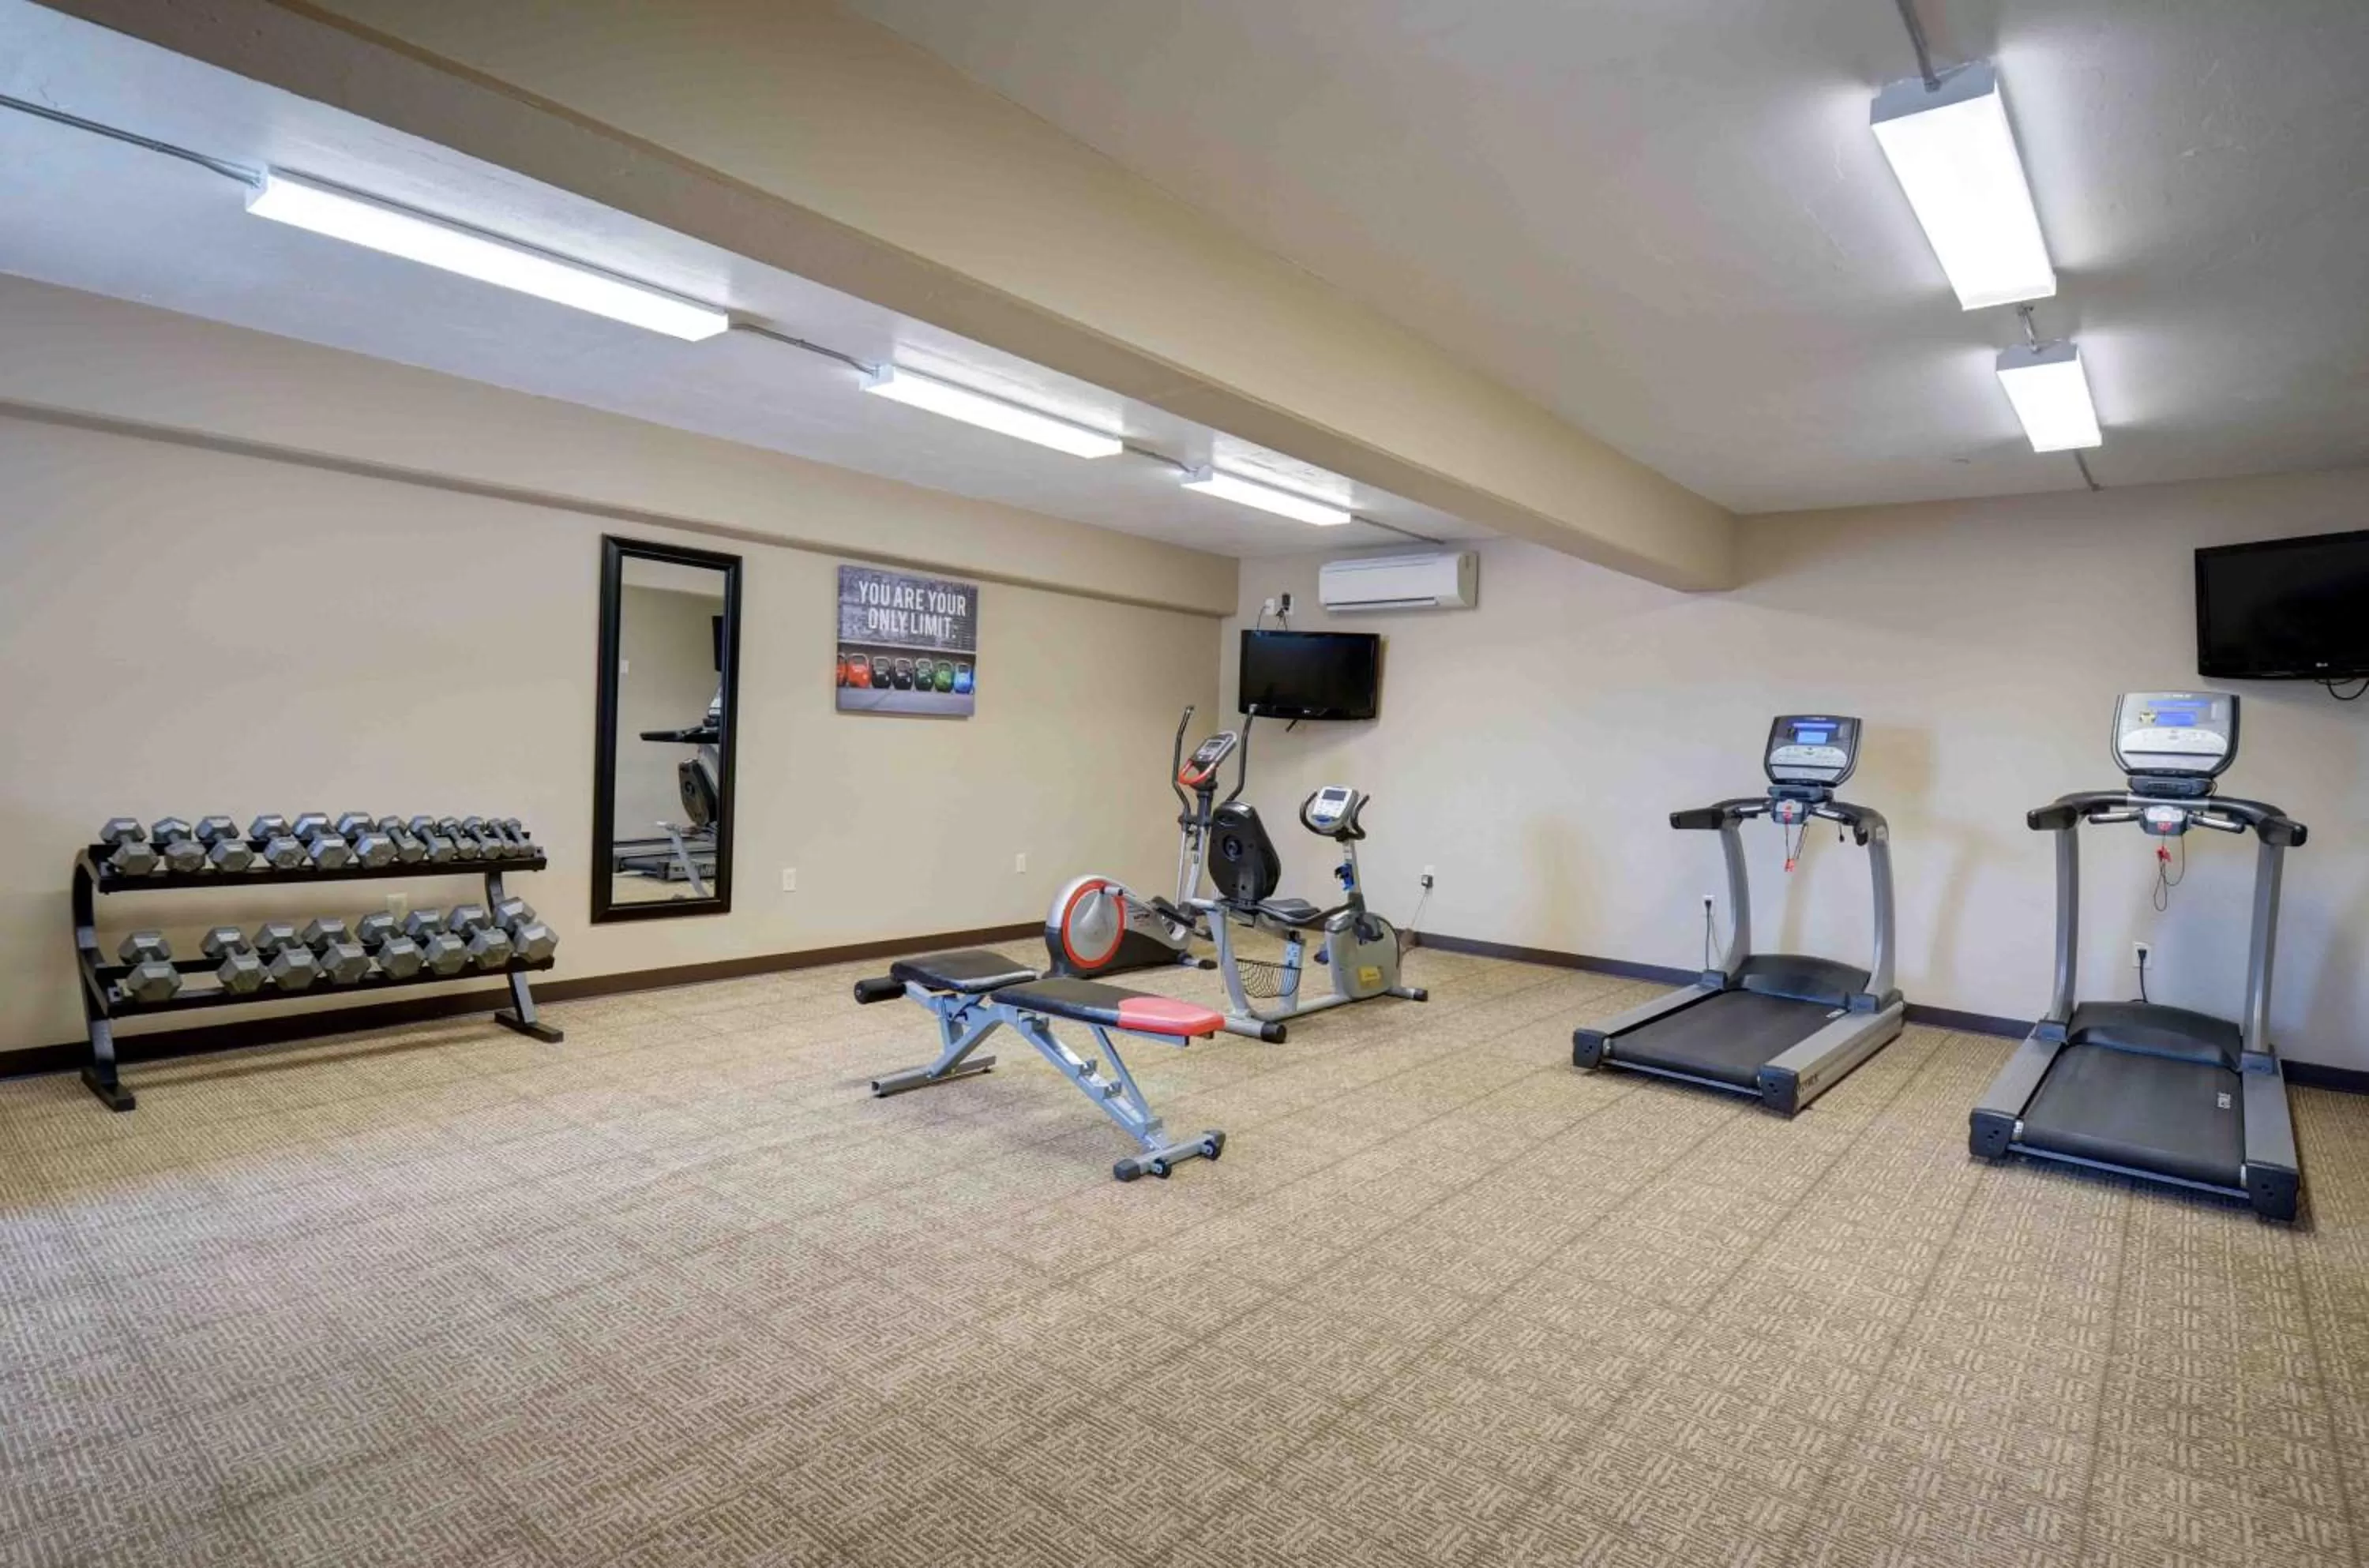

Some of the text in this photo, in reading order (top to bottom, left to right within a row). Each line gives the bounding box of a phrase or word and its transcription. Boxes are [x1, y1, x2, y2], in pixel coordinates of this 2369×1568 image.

[859, 581, 967, 617] YOU ARE YOUR
[868, 608, 908, 632] ONLY
